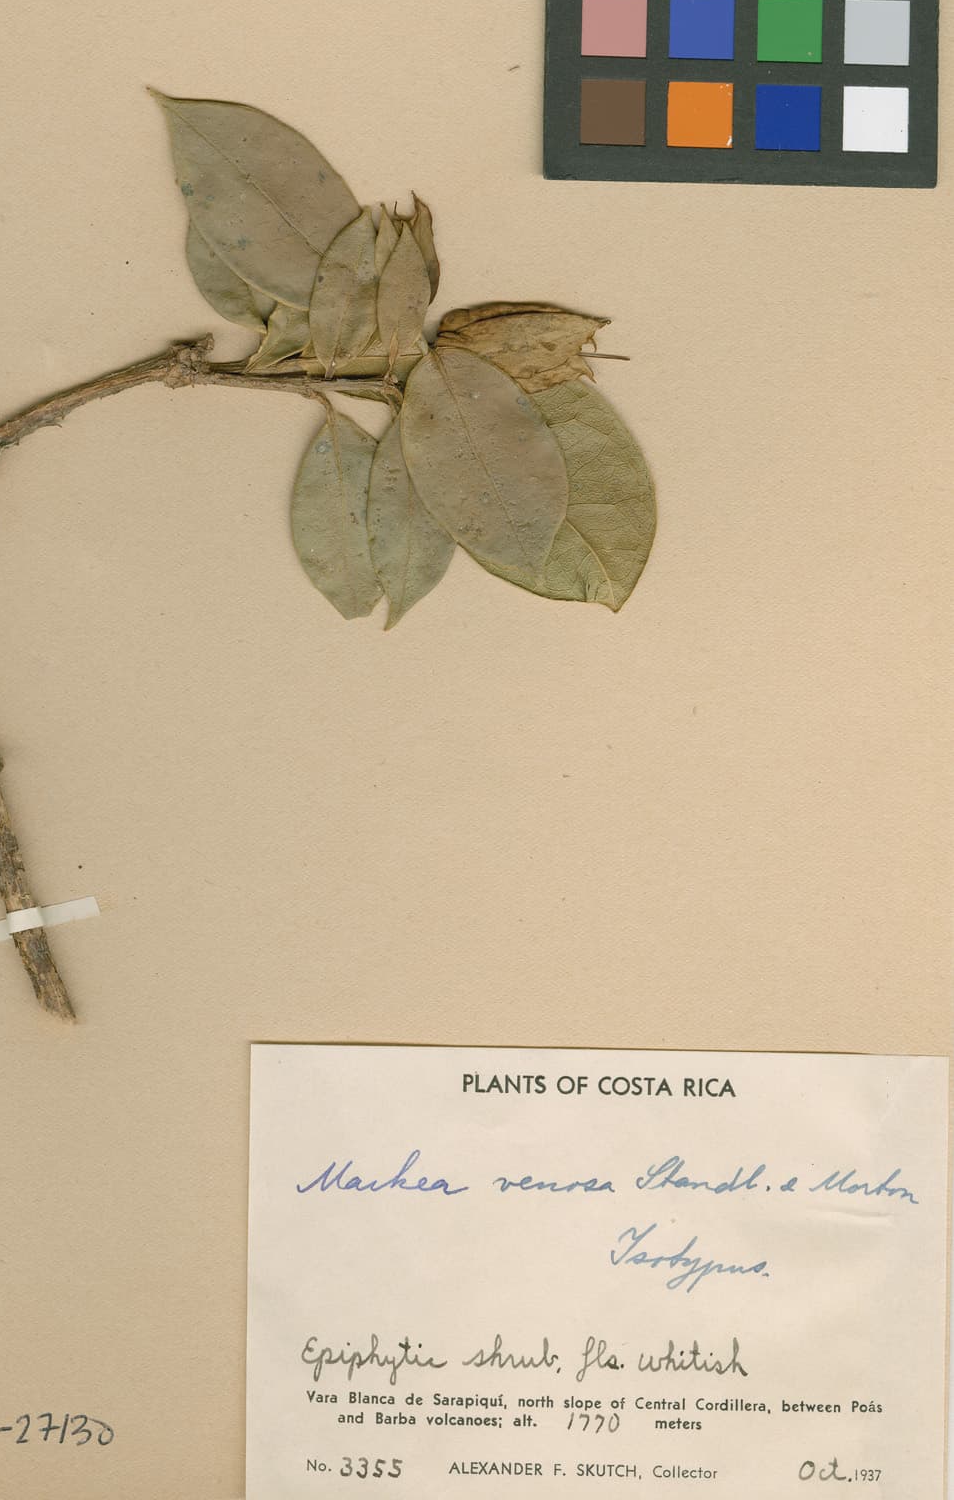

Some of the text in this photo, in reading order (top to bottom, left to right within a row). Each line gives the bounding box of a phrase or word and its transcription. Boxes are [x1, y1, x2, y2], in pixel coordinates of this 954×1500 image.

[462, 1073, 737, 1098] PLANTS OF COSTA RICA
[493, 1175, 615, 1194] venosa
[301, 1334, 447, 1385] Epiphytic
[462, 1334, 561, 1373] shrub,
[638, 1337, 748, 1377] whitish
[306, 1391, 883, 1414] Vara Blanca de Sarapiquí, north slope of Central Cordillera, between Poás
[338, 1411, 702, 1435] and Barba volcanoes; alt. 1770 meters
[306, 1457, 881, 1482] No. 3355 ALEXANDER F. SKUTCH, Collector Oct. 1937
